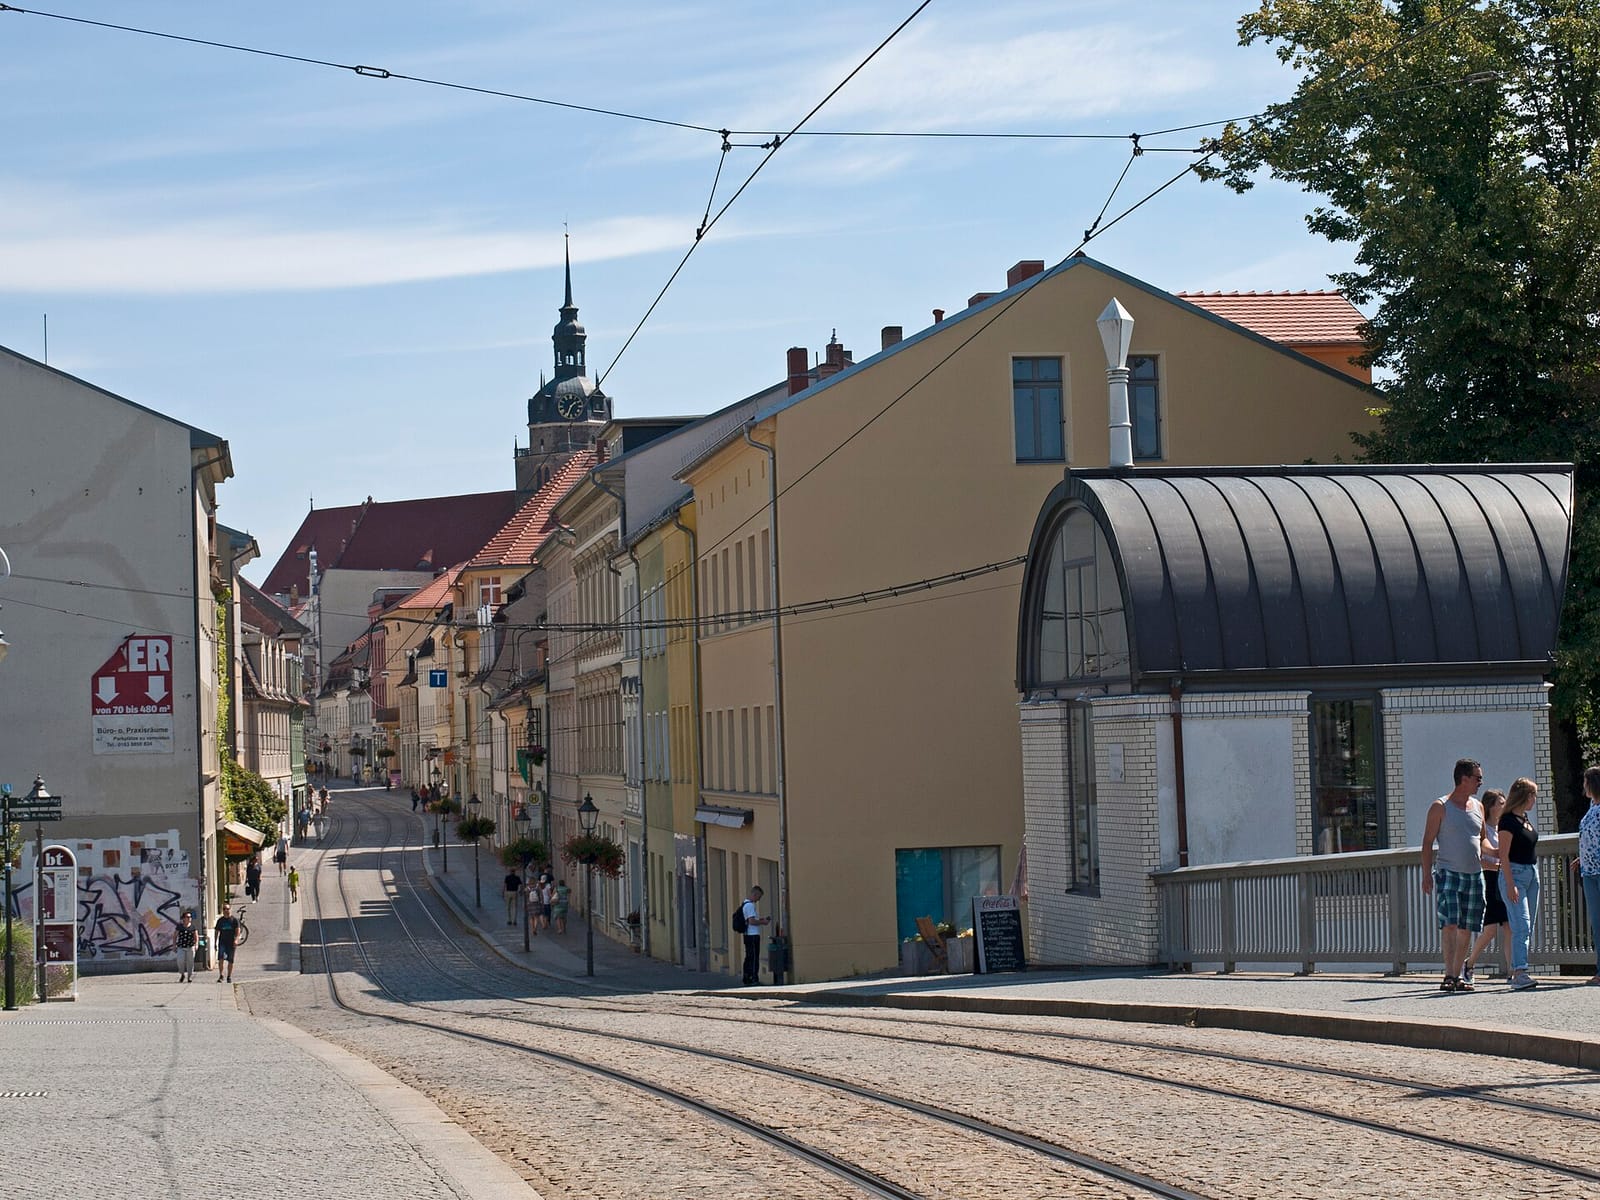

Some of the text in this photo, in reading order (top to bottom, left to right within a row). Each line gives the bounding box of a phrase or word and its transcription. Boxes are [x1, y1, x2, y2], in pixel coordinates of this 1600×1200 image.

[432, 672, 445, 686] T
[112, 705, 124, 714] 70
[125, 705, 138, 713] bis
[139, 704, 157, 713] 480
[45, 852, 64, 866] bt
[49, 950, 59, 958] bt
